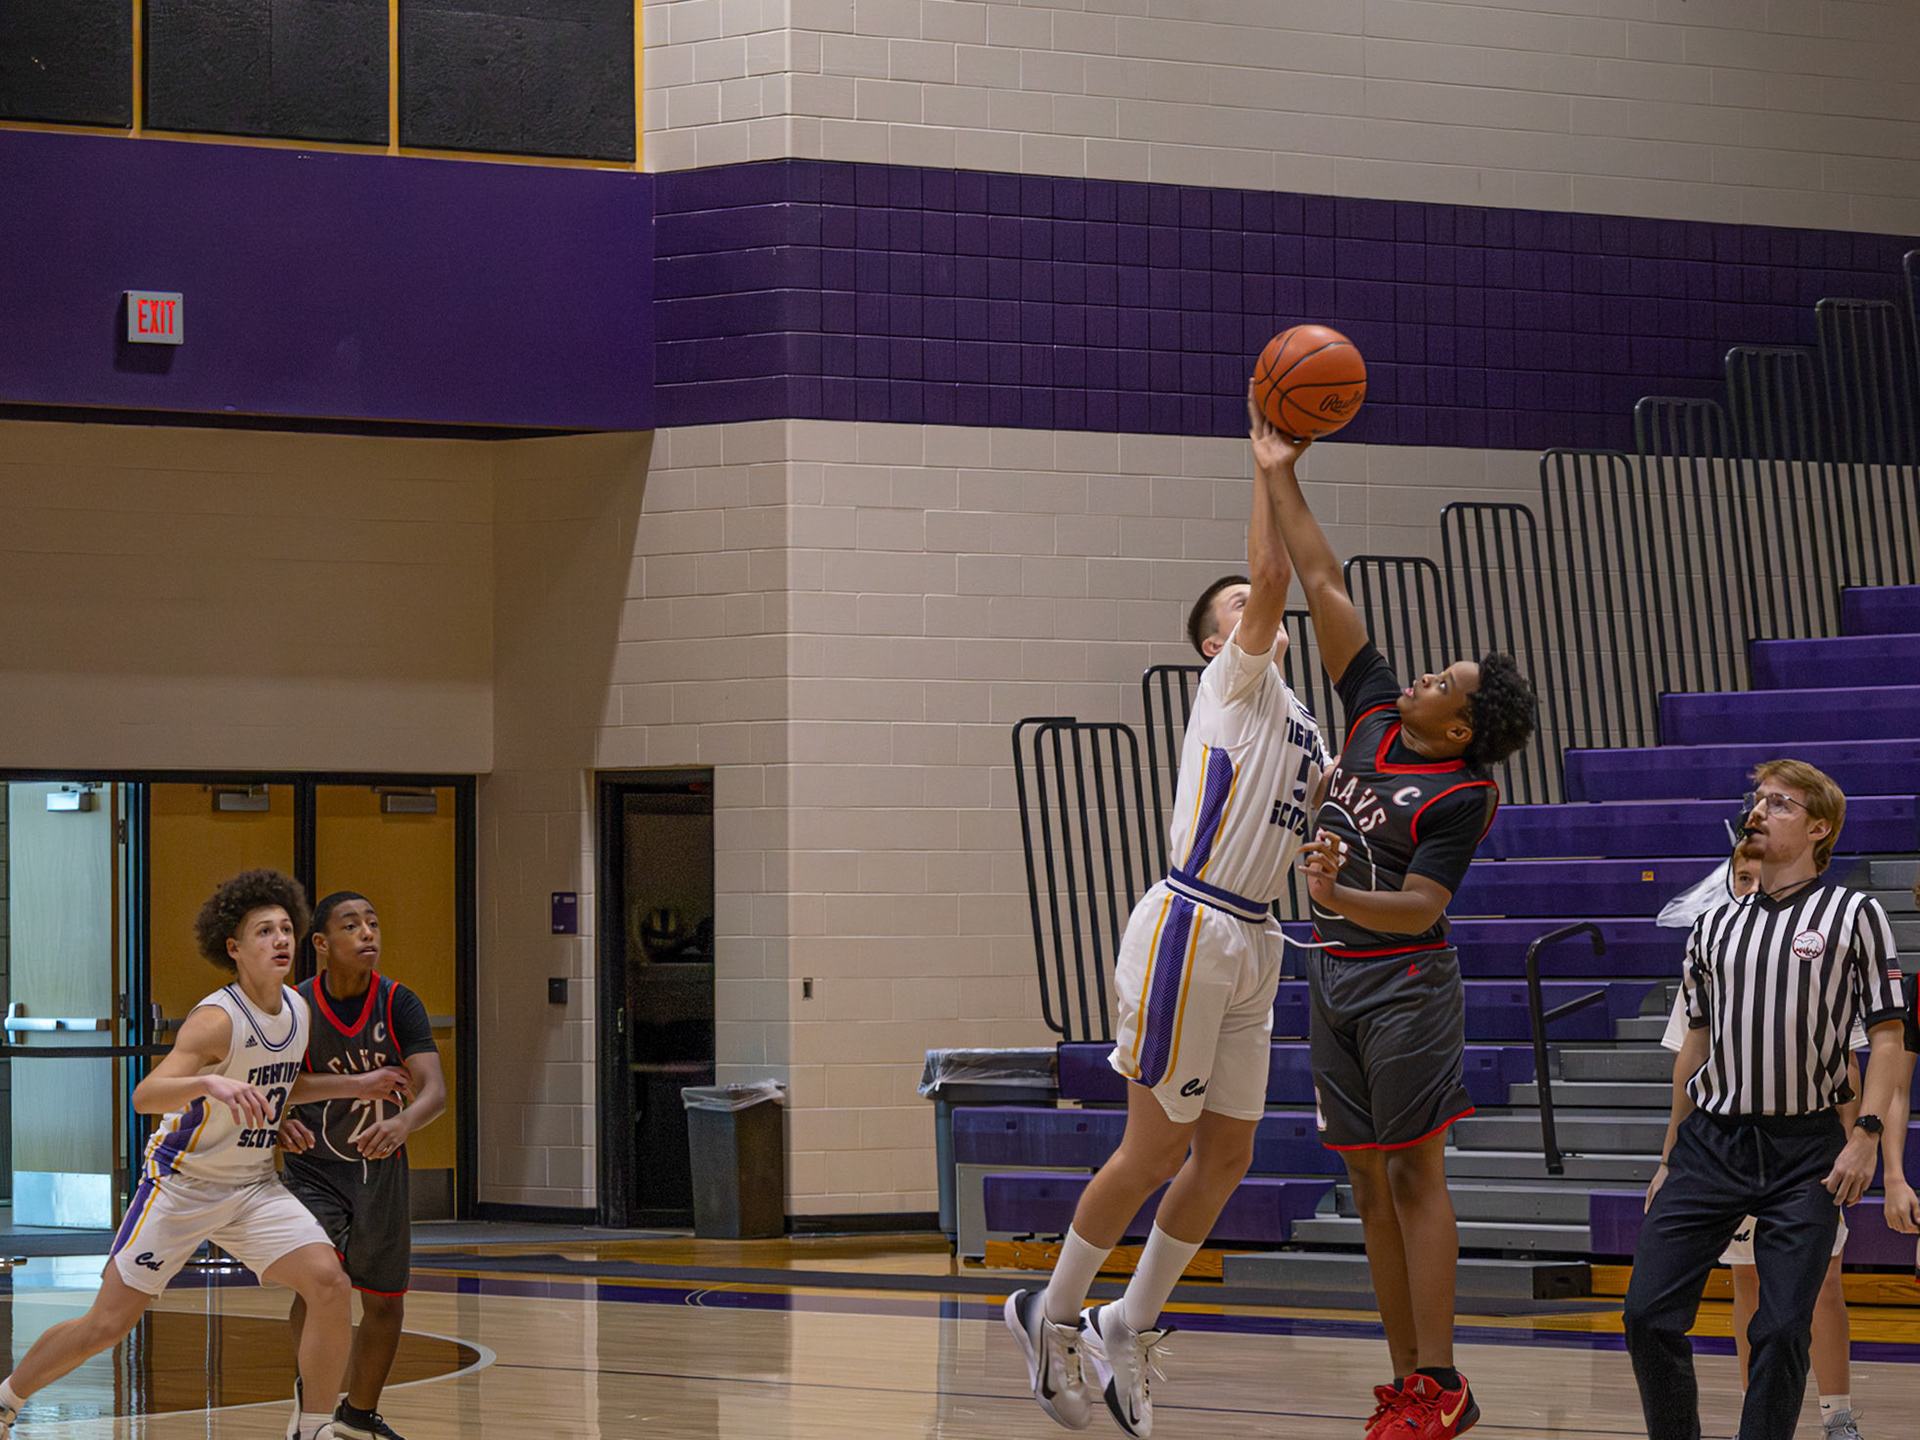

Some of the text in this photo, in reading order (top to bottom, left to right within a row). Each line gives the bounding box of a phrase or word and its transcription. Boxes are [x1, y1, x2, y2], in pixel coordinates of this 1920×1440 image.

[137, 298, 176, 335] EXIT
[1329, 767, 1388, 833] CAVS
[1392, 785, 1422, 807] C
[373, 1021, 387, 1043] C
[135, 1251, 165, 1272] Cal
